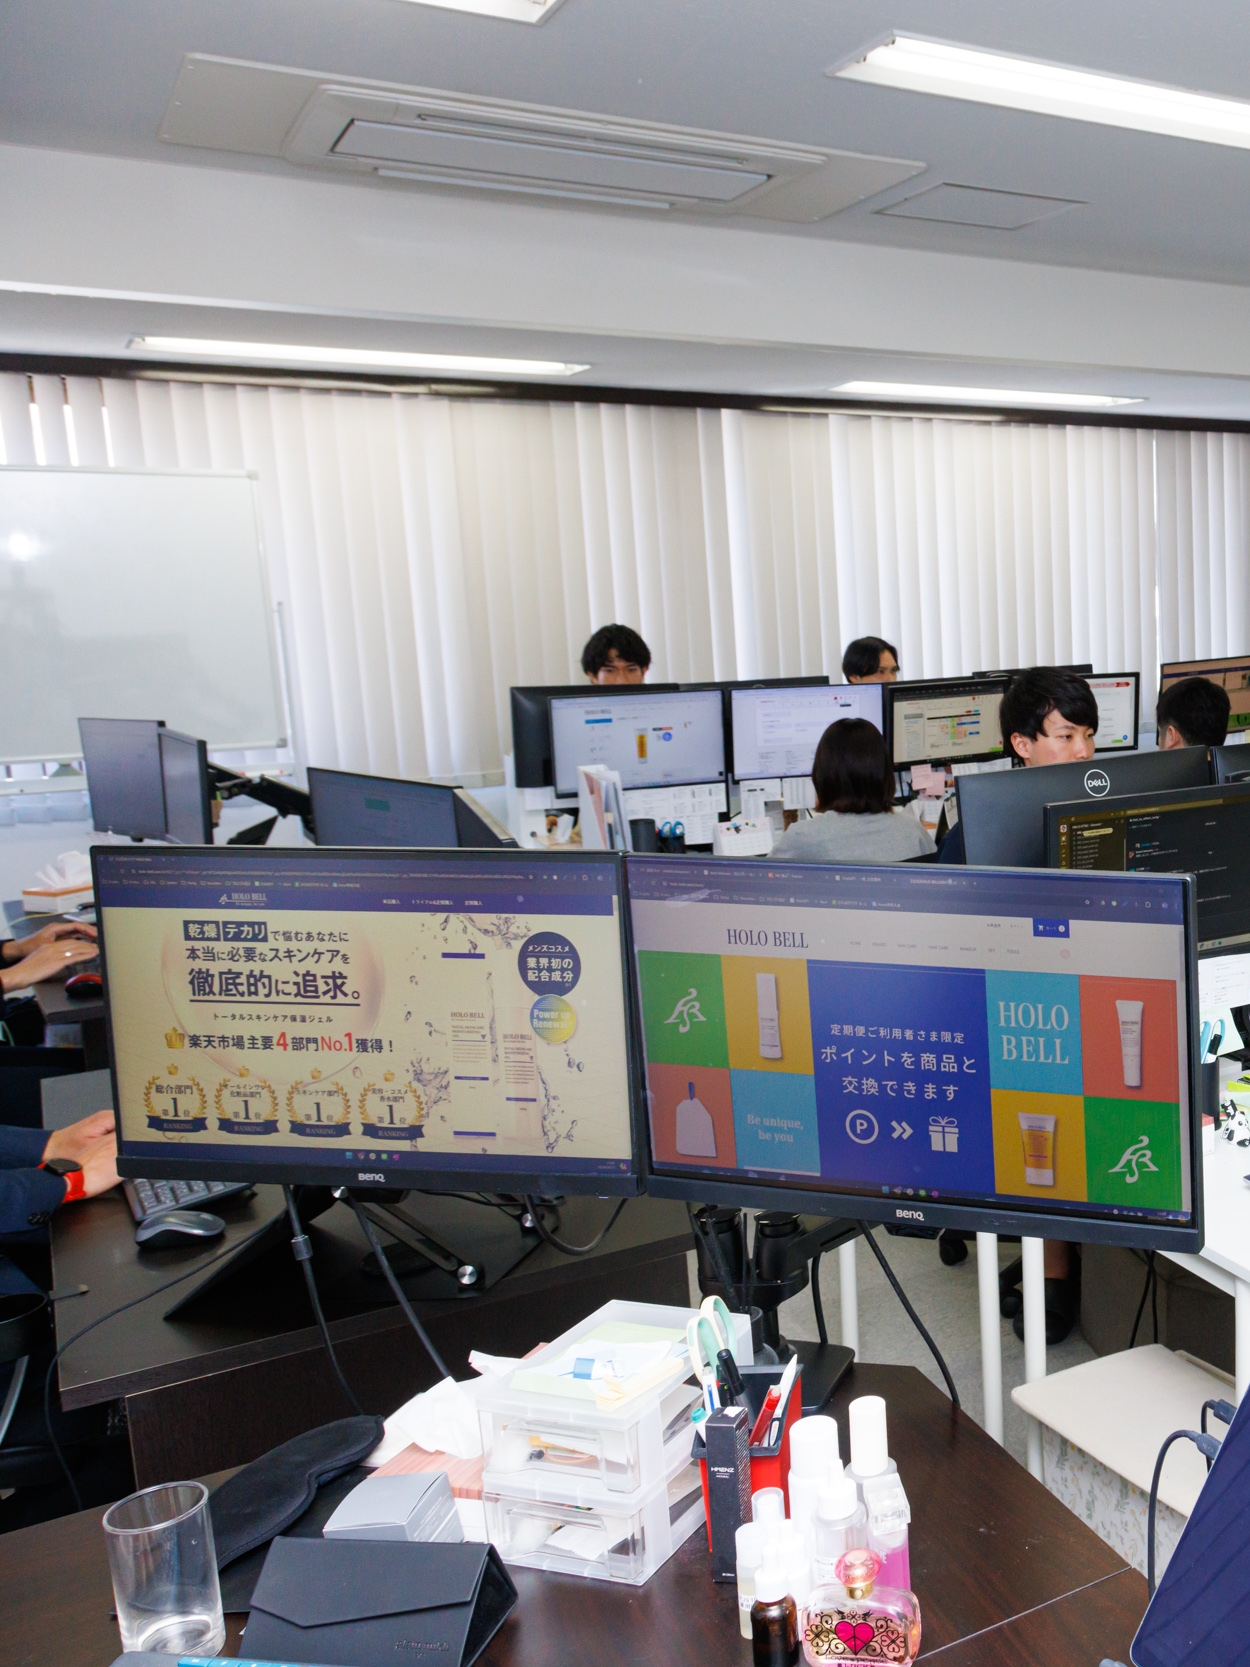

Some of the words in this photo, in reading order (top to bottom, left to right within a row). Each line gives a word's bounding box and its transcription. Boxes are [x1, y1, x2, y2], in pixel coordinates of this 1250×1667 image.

[1088, 779, 1107, 787] DELL
[232, 892, 250, 900] HOLO
[252, 893, 267, 901] BELL
[188, 923, 218, 938] 乾燥
[225, 924, 266, 939] テカリ
[270, 930, 349, 942] で悩むあなたに
[727, 929, 768, 946] HOLO
[773, 931, 809, 948] BELL
[186, 946, 350, 964] 本当に必要なスキンケアを
[526, 957, 573, 969] 業界初の
[527, 970, 574, 982] 配合成分
[188, 968, 360, 1000] 徹底的に追求。
[533, 1009, 559, 1019] Power
[561, 1012, 571, 1020] up
[998, 1002, 1069, 1031] HOLO
[830, 1024, 965, 1044] 定期便ご利用者さま限定
[1001, 1035, 1069, 1064] BELL
[821, 1046, 977, 1073] ポイントを商品と
[155, 1084, 193, 1095] 総合部門
[842, 1076, 958, 1101] 交換できます
[747, 1114, 760, 1125] Be
[763, 1118, 804, 1130] unique,
[856, 1119, 868, 1134] P
[758, 1129, 771, 1141] be
[774, 1133, 794, 1143] you
[358, 1172, 385, 1182] BenQ
[895, 1209, 924, 1221] BenQ
